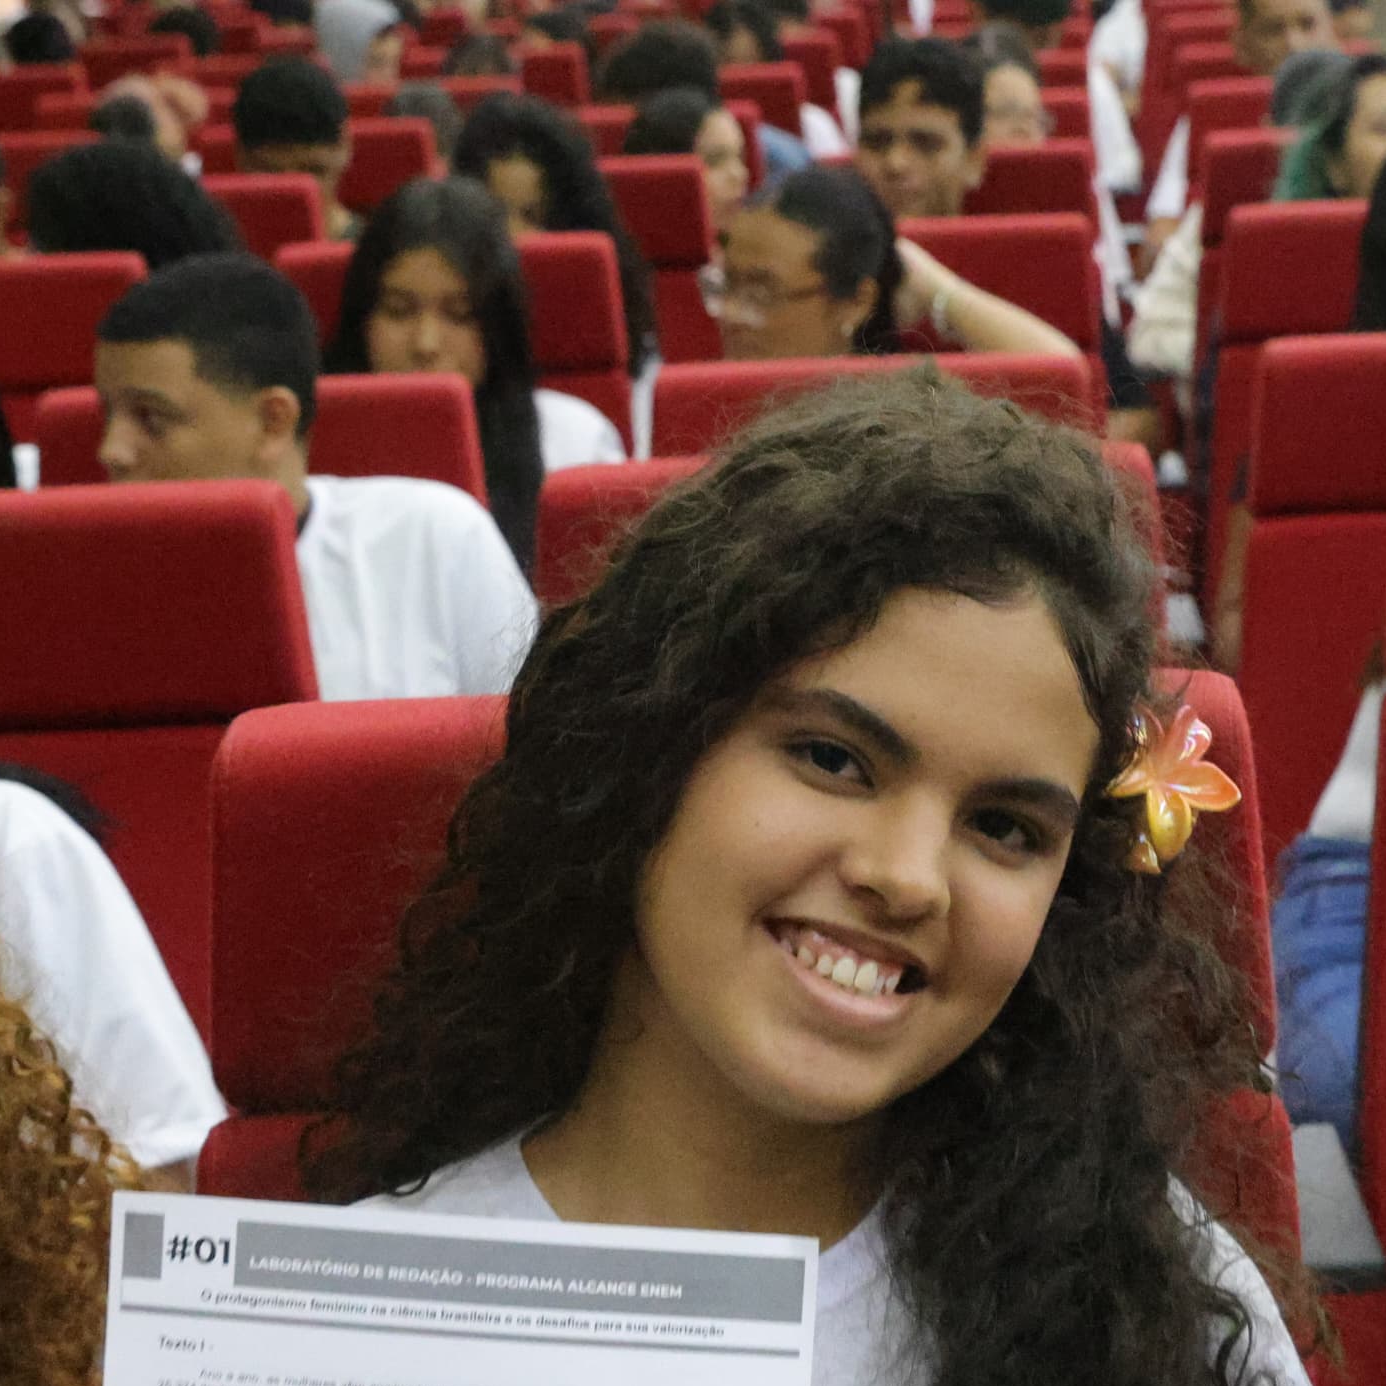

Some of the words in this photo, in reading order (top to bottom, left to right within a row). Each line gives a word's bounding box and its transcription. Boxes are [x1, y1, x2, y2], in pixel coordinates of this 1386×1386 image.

[166, 1235, 231, 1266] #01
[249, 1255, 360, 1279] LABORATÓRIO
[363, 1267, 385, 1281] DE
[388, 1268, 463, 1286] REDAÇÃO
[476, 1272, 563, 1292] PROGRAMA
[568, 1279, 637, 1297] ALCANCE
[640, 1283, 683, 1300] ENEM
